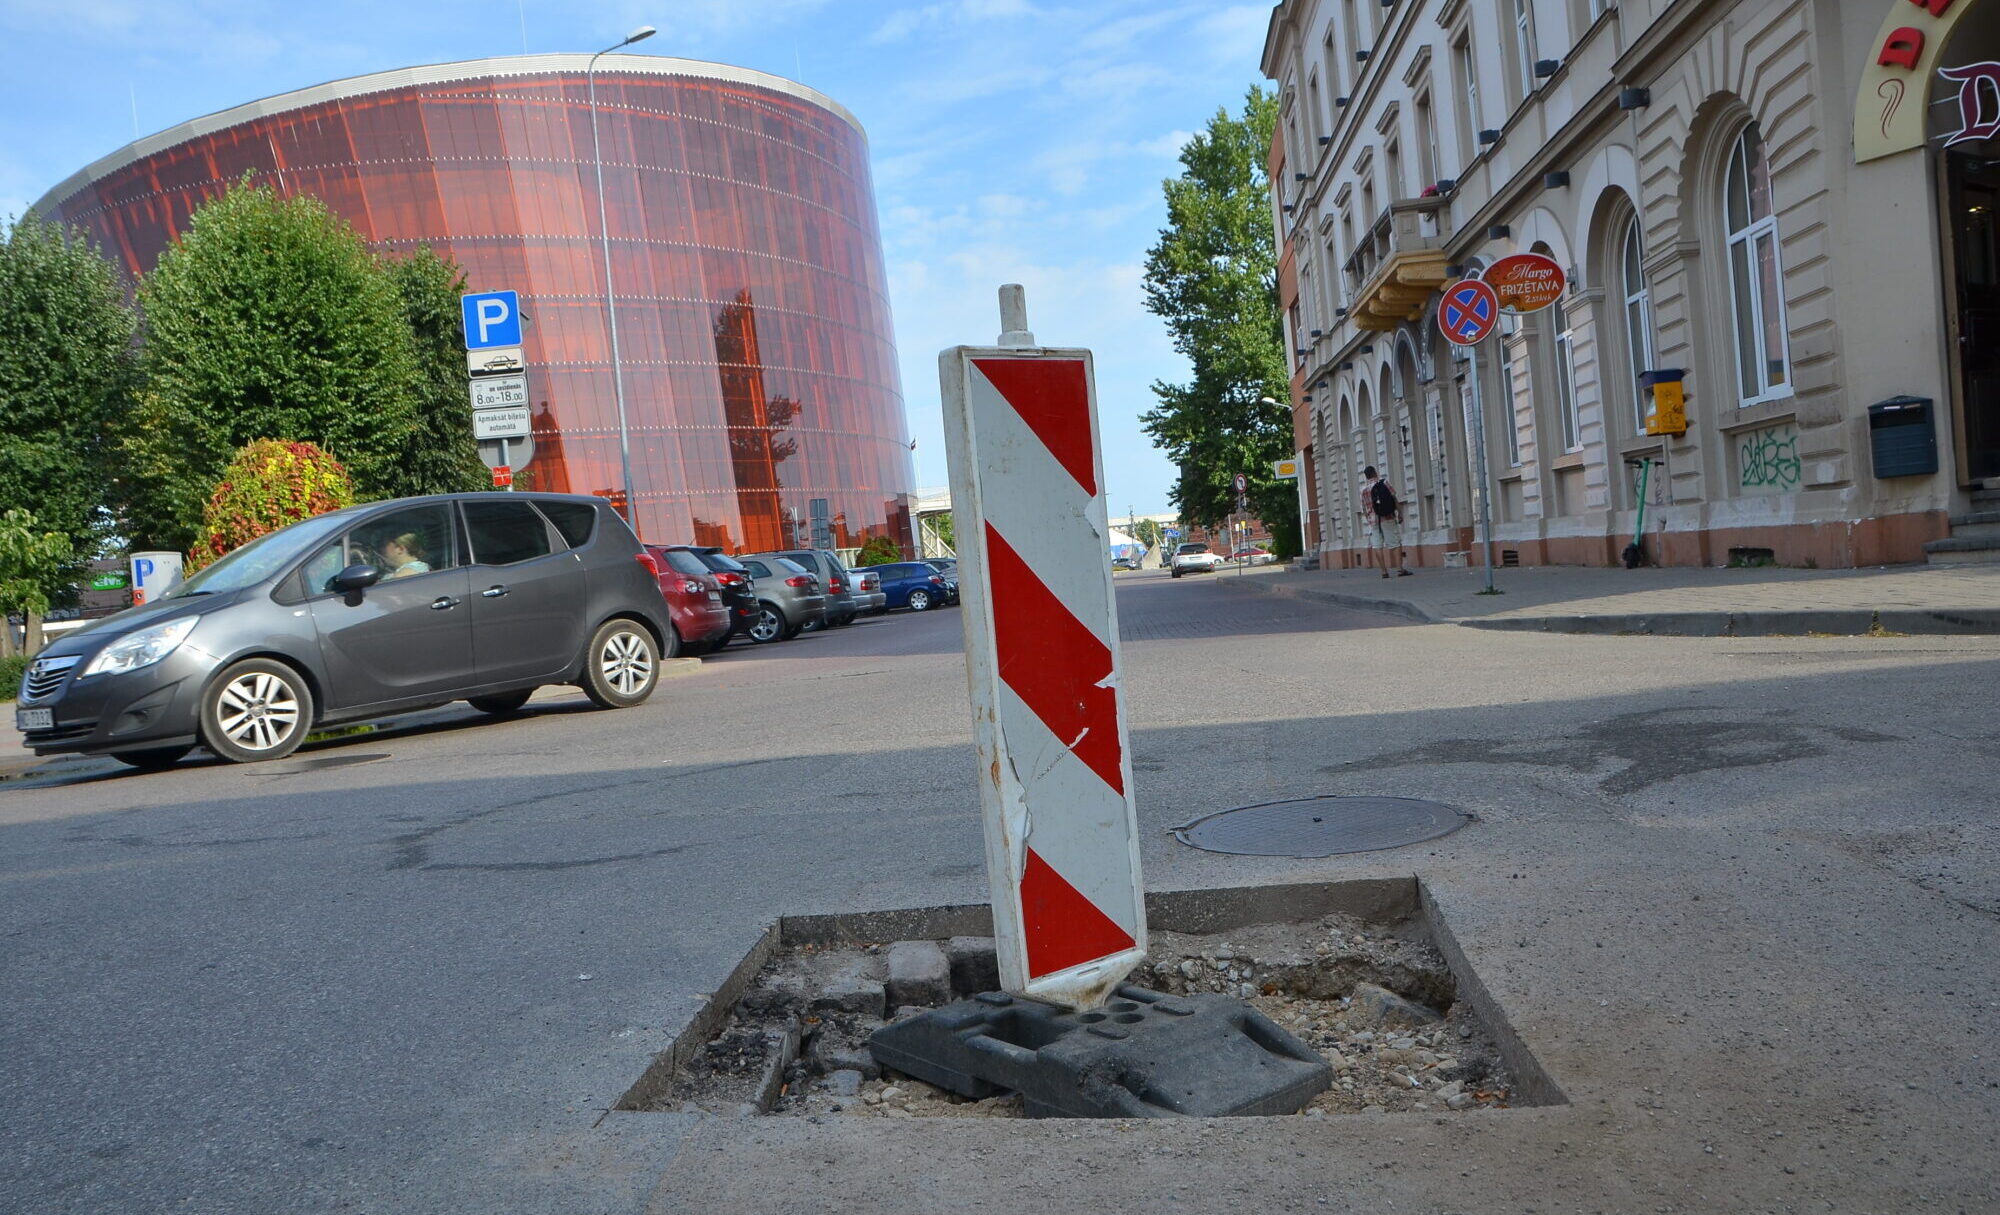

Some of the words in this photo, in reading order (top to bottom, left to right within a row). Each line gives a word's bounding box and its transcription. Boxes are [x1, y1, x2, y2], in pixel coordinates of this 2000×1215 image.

[1507, 262, 1553, 280] Margo
[1500, 280, 1560, 296] FRIZĒTAVA
[476, 298, 509, 343] P
[135, 559, 154, 587] P
